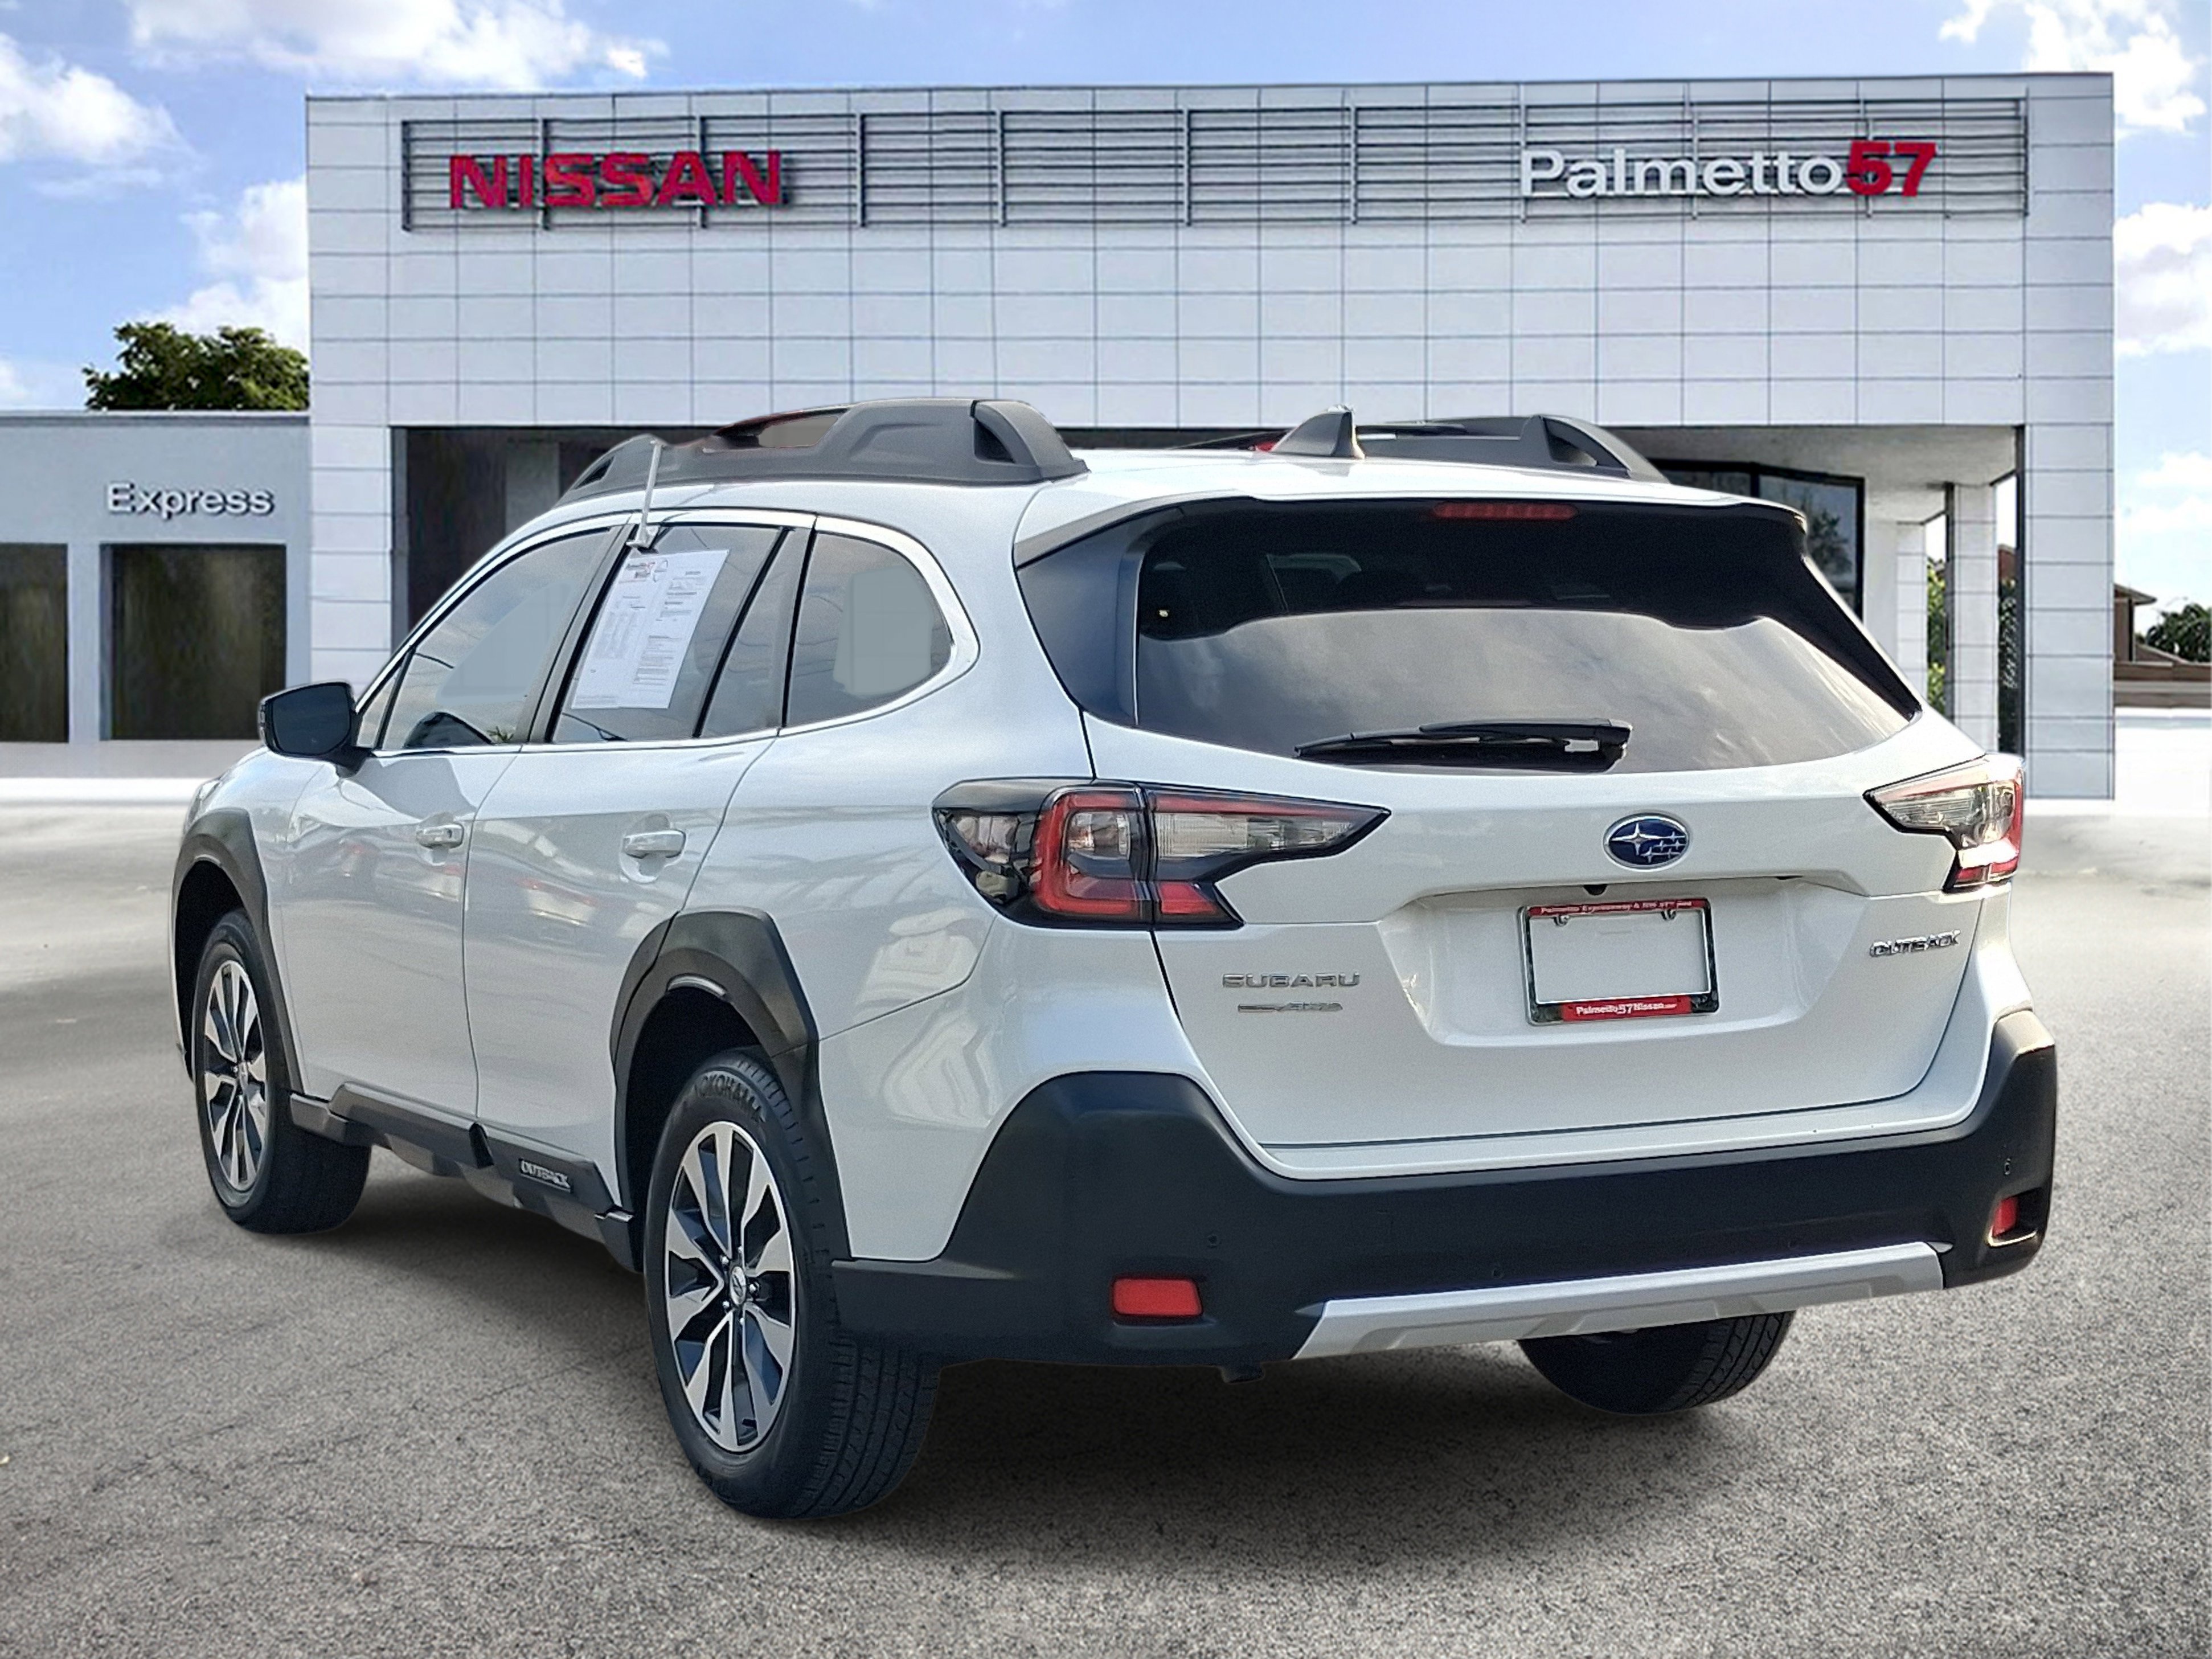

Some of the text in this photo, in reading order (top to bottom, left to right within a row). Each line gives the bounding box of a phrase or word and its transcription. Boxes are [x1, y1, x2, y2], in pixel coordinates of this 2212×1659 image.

[450, 150, 781, 209] NISSAN
[107, 482, 276, 520] Express
[1222, 972, 1361, 988] SUBARU
